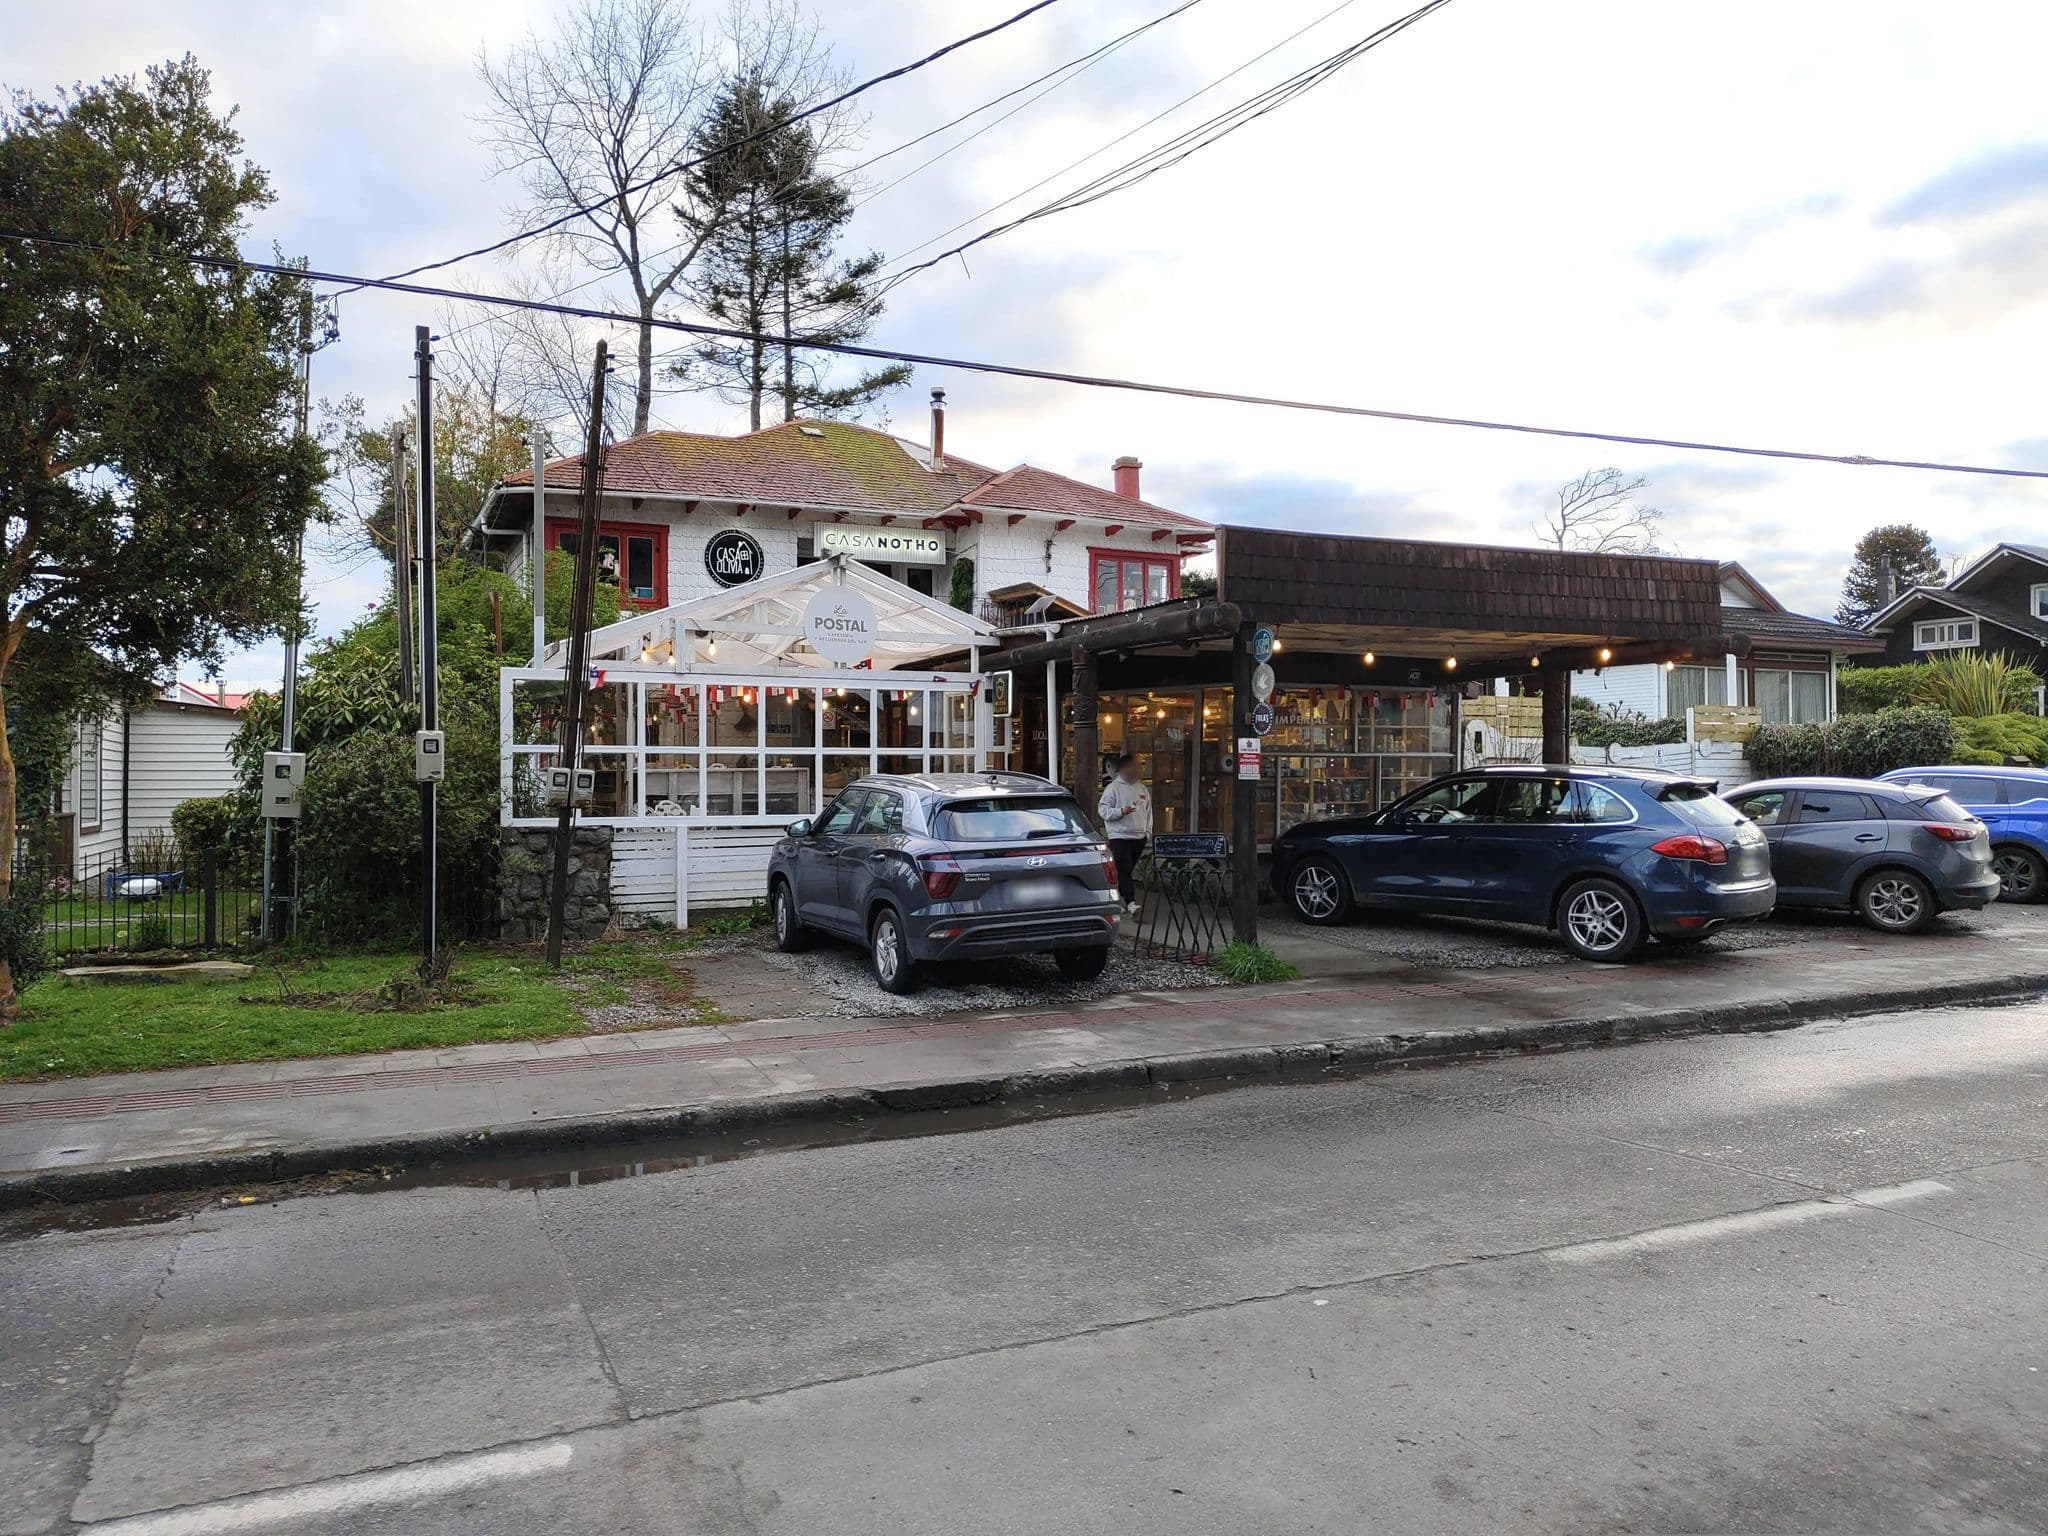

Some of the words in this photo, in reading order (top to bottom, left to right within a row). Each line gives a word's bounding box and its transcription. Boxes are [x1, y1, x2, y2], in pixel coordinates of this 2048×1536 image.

[716, 547, 741, 561] CASA
[716, 560, 743, 574] OLIVIA
[833, 604, 849, 615] La
[814, 617, 868, 632] POSTAL
[1275, 715, 1328, 725] IMPERIAL
